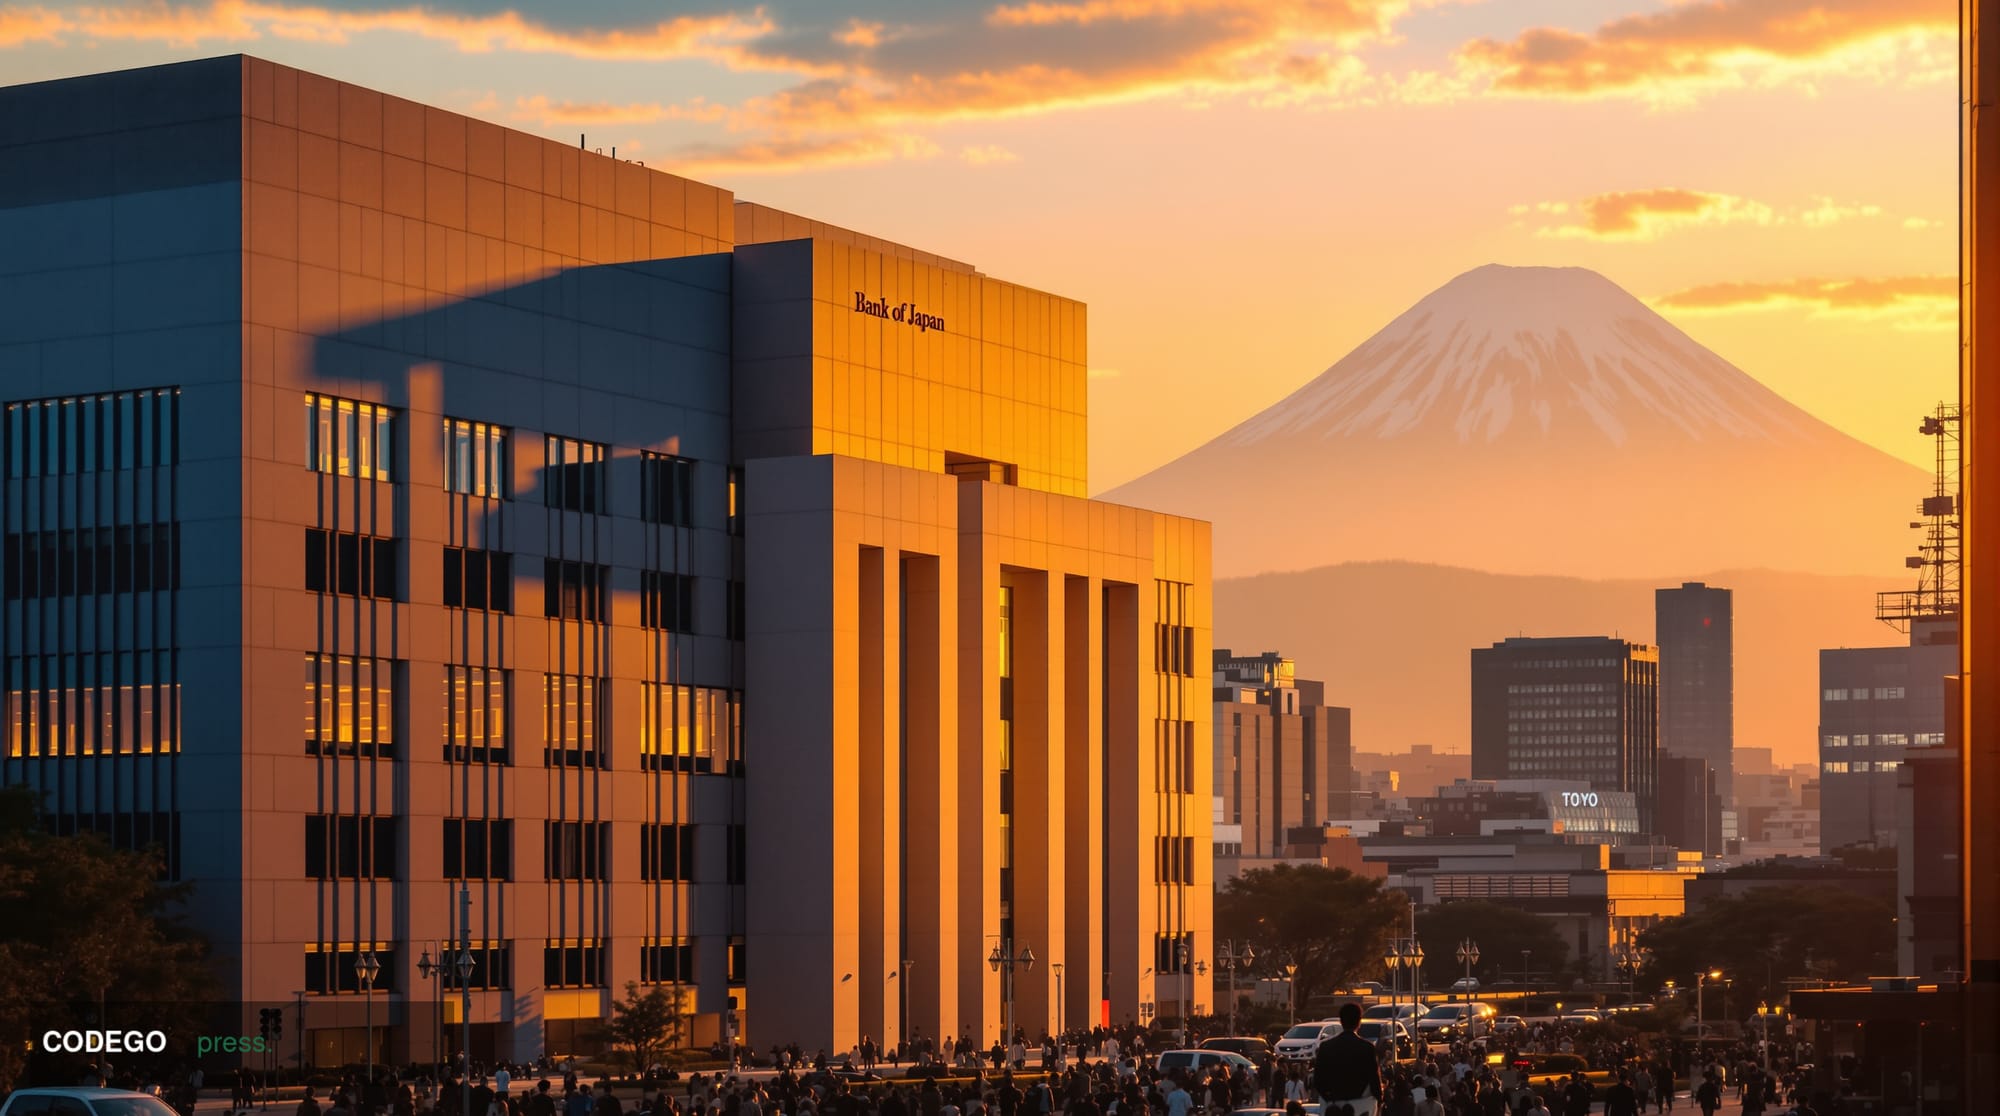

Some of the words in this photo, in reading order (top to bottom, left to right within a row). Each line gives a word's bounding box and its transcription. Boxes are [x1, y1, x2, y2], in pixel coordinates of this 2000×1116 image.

[855, 291, 889, 319] Bank
[892, 302, 907, 322] of
[908, 303, 945, 332] Japan
[1562, 792, 1598, 807] TOYO
